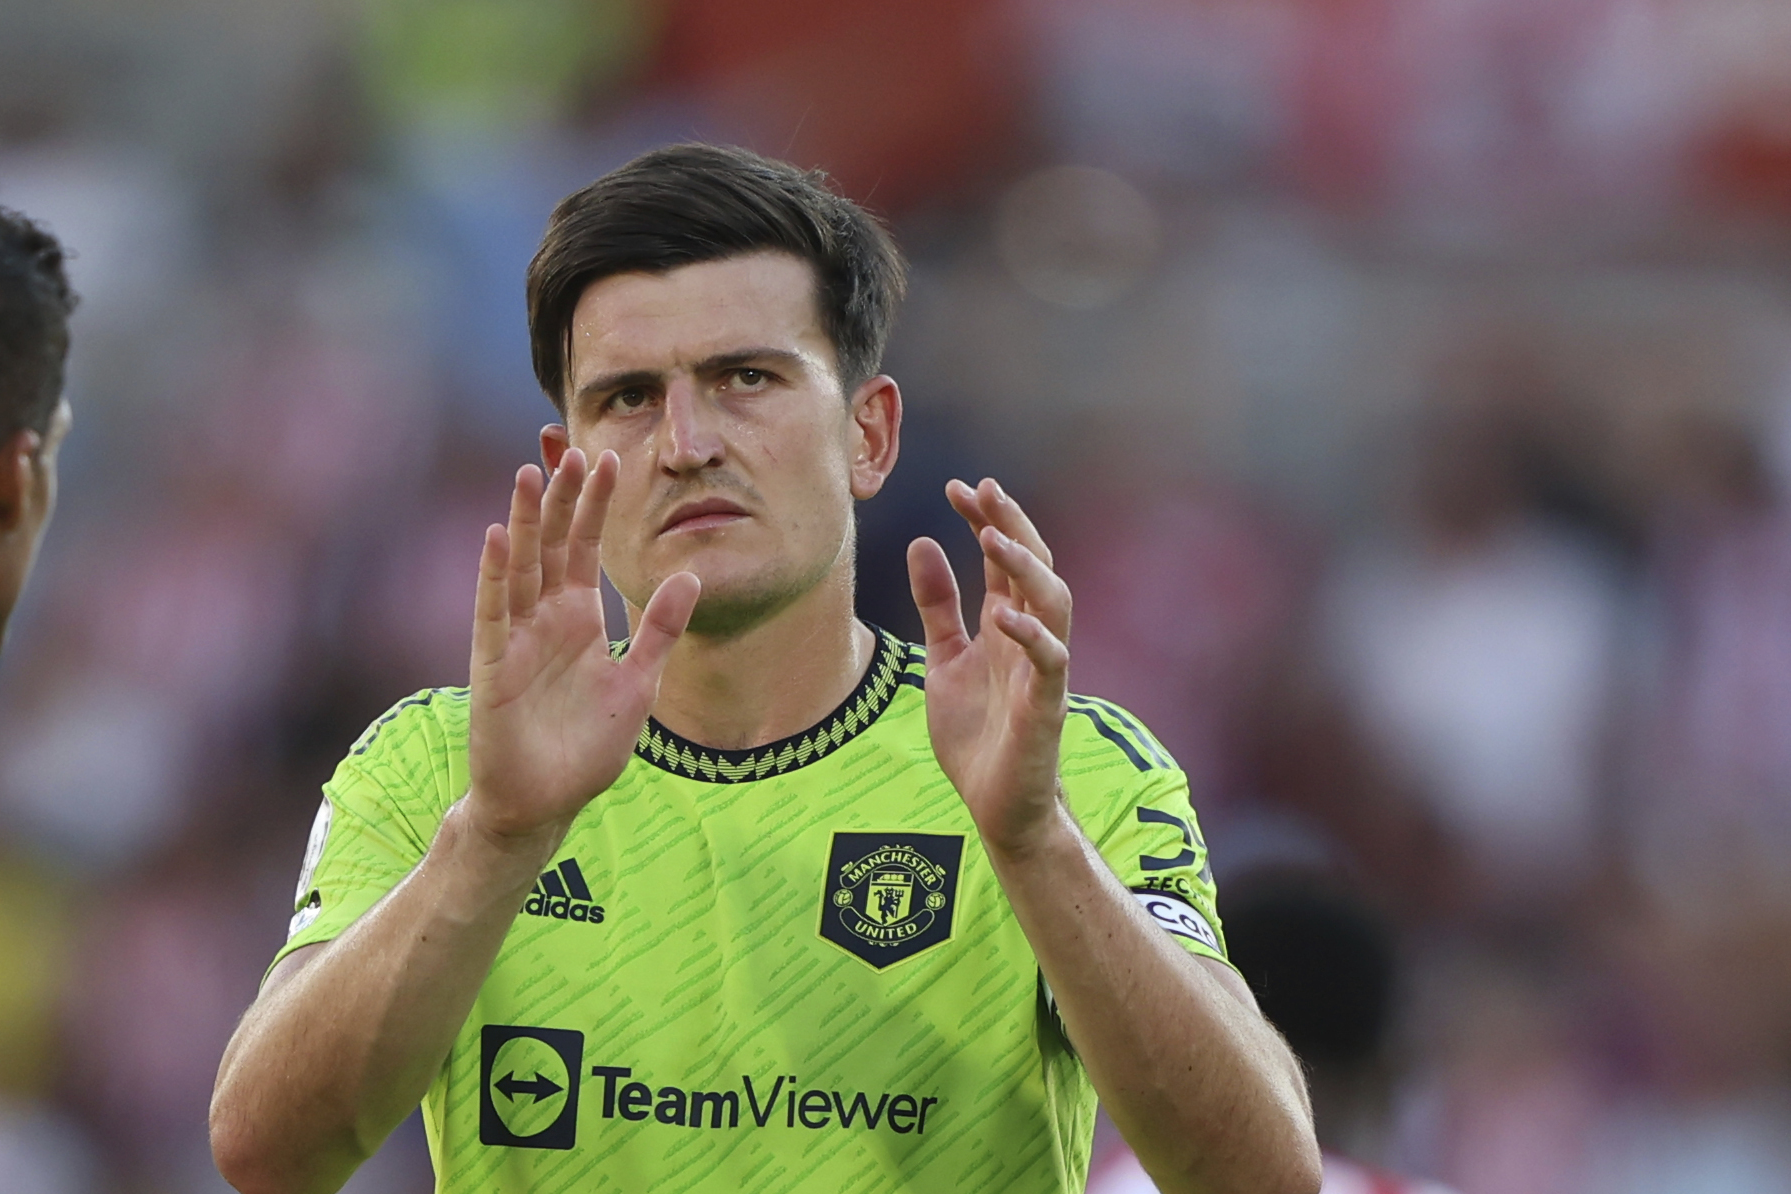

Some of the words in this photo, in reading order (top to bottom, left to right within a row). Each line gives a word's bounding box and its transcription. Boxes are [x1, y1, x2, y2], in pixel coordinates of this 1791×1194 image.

[848, 851, 938, 886] MANCHESTER
[519, 893, 606, 924] didas
[854, 920, 918, 939] UNITED
[591, 1065, 938, 1135] TeamViewer
